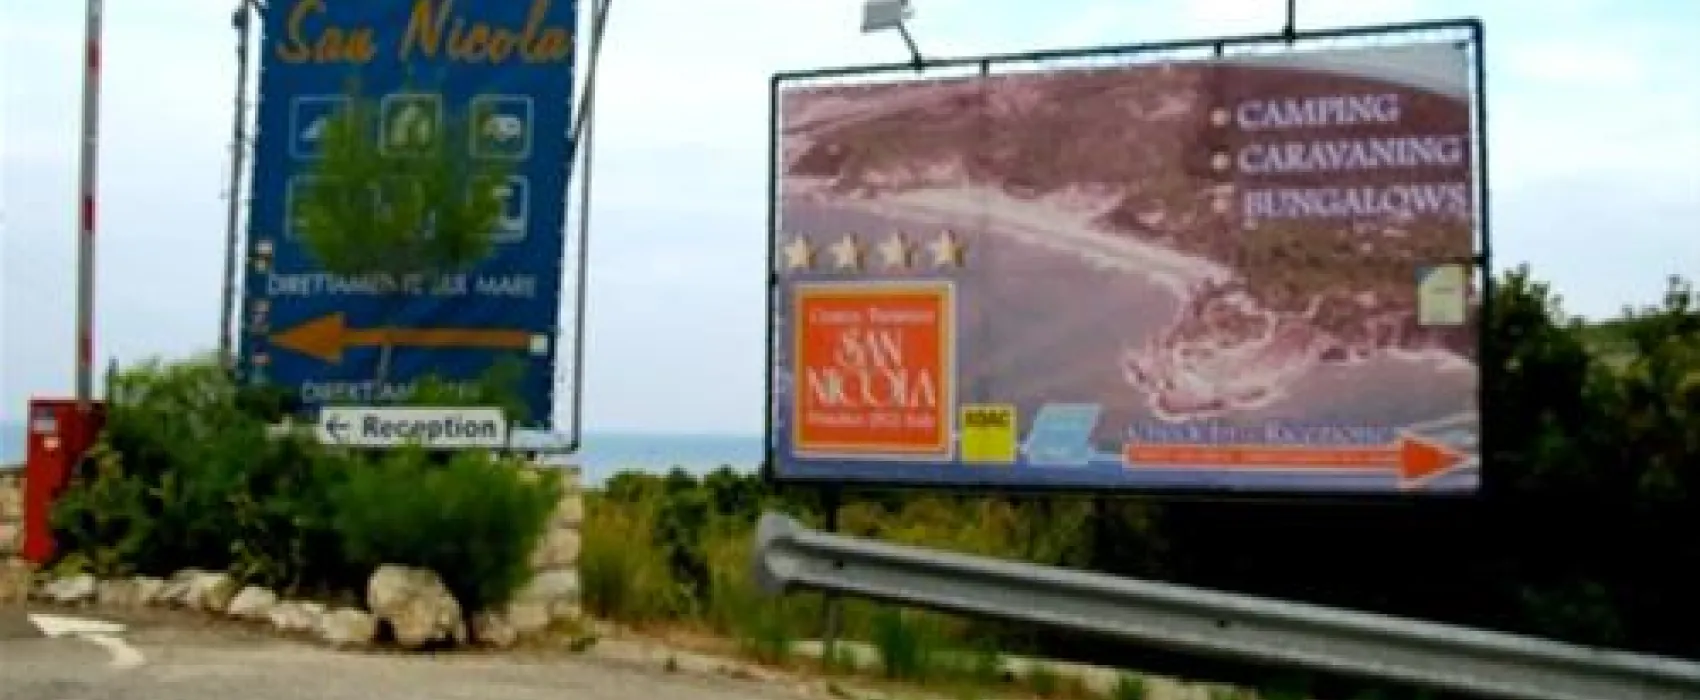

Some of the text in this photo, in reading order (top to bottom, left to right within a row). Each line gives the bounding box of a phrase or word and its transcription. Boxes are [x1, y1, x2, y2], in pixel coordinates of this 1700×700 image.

[276, 0, 572, 64] San Nicola
[1236, 93, 1400, 132] CAMPING
[1237, 135, 1463, 173] CARAVANING
[1243, 182, 1467, 218] BUNGALOWS
[362, 414, 500, 442] Reception
